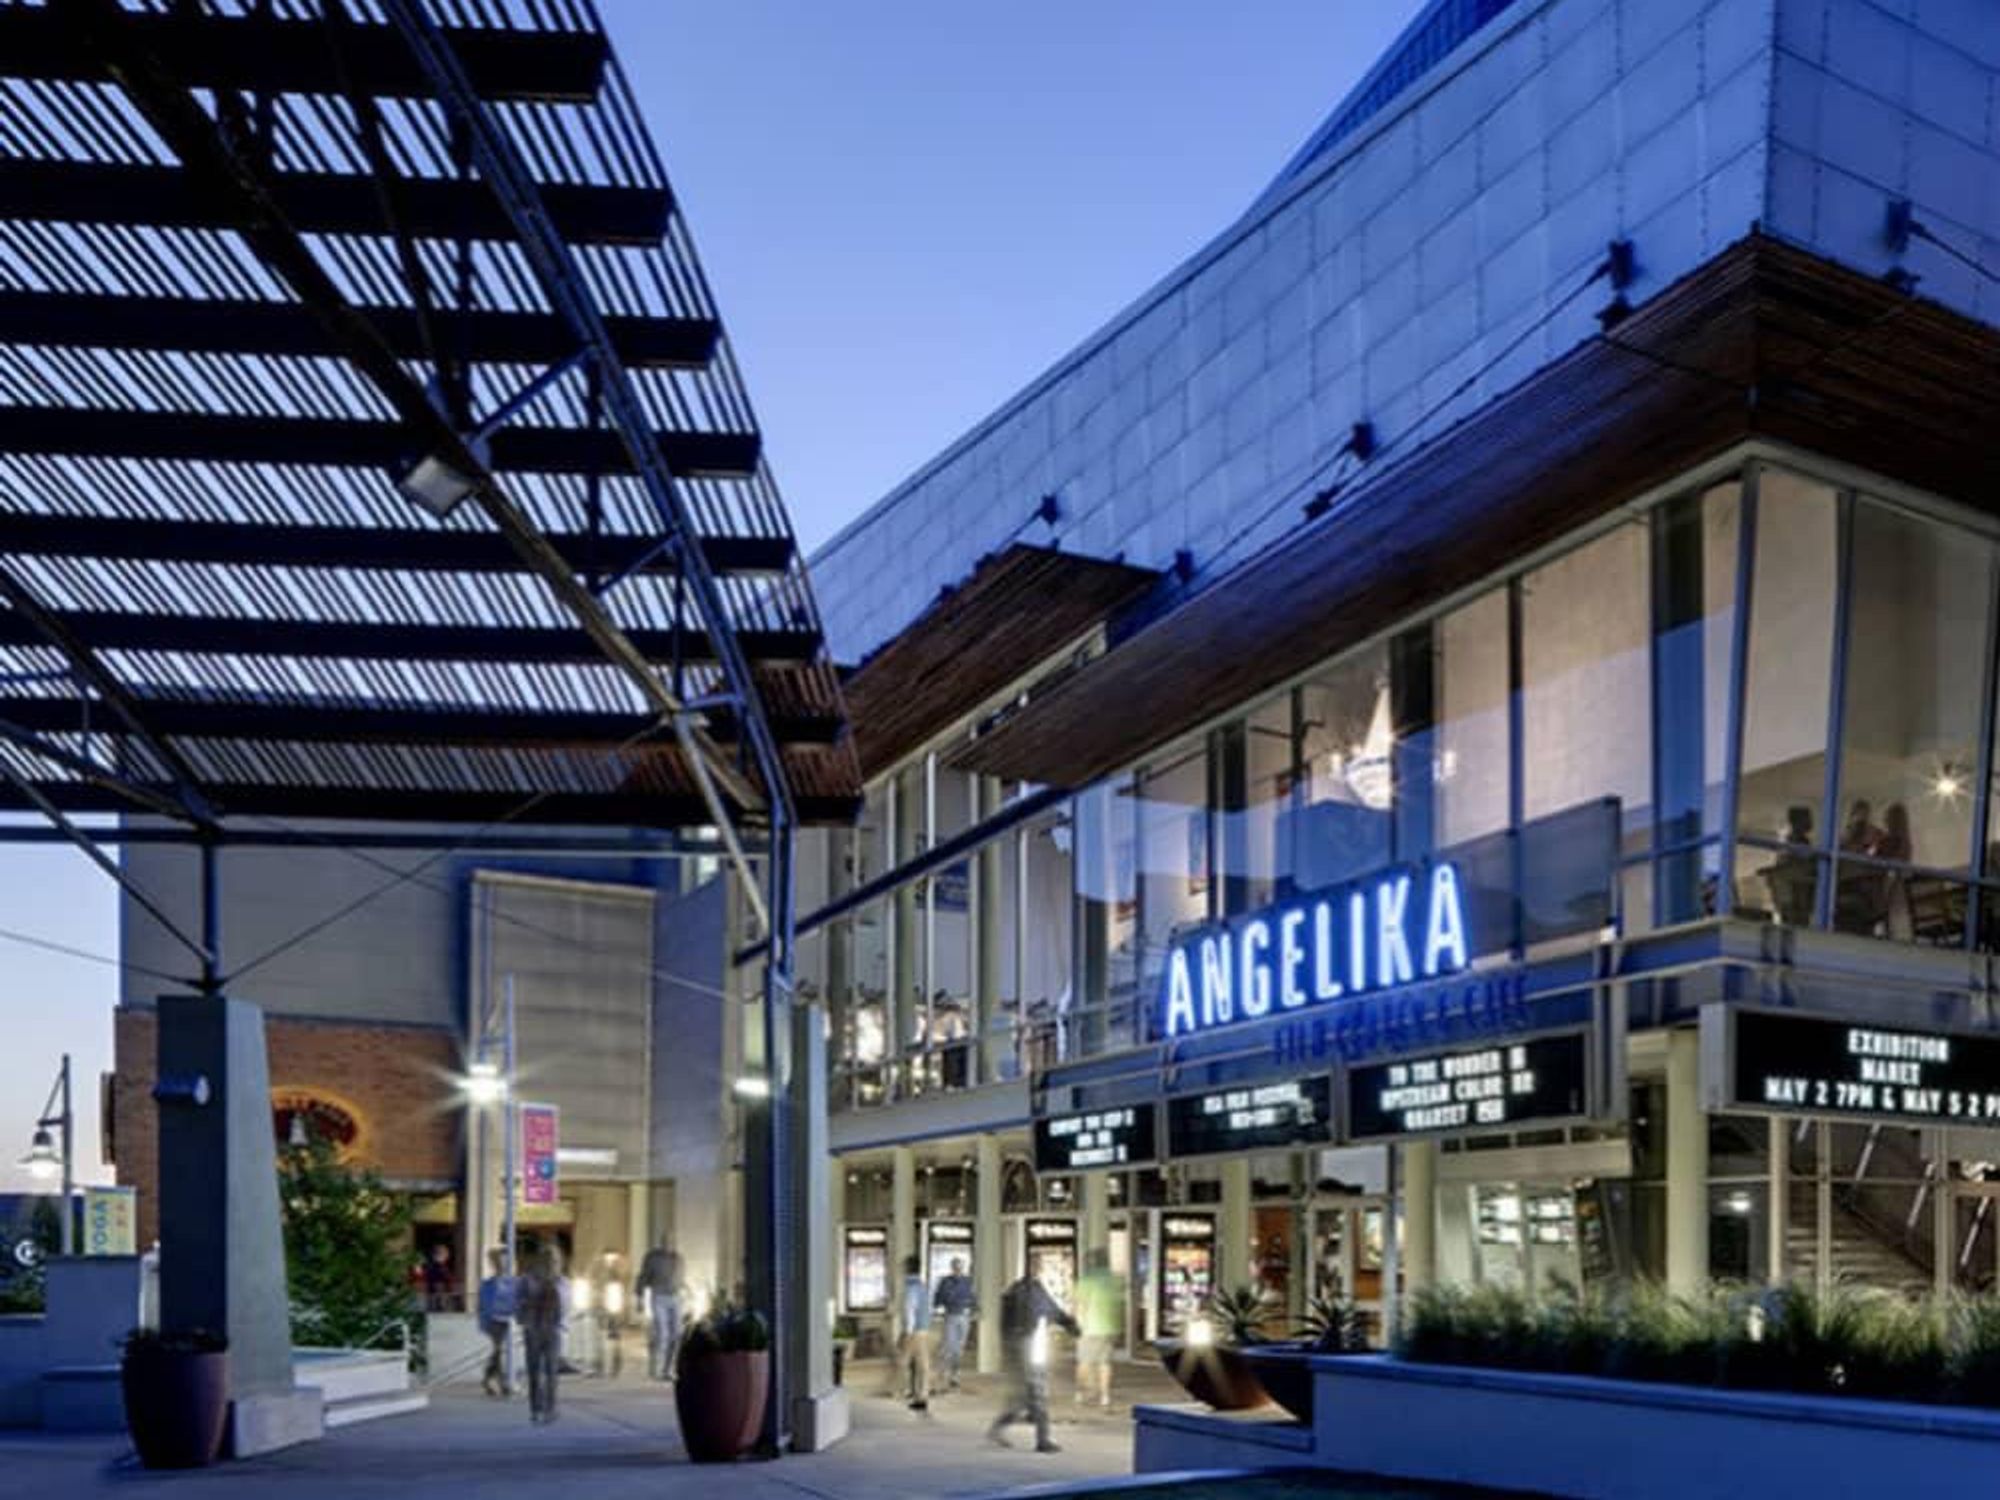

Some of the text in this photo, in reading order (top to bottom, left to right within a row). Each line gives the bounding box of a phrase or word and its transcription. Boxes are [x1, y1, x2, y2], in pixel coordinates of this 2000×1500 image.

[1166, 863, 1468, 1036] ANGELIKA
[1849, 1029, 1949, 1062] EXHIBITION
[1765, 1077, 1808, 1102] MAY
[1816, 1081, 1829, 1105] 2
[1836, 1082, 1874, 1108] 7PM
[1883, 1086, 1895, 1110] &
[1903, 1088, 1940, 1113] MAY
[1968, 1094, 1980, 1118] 2
